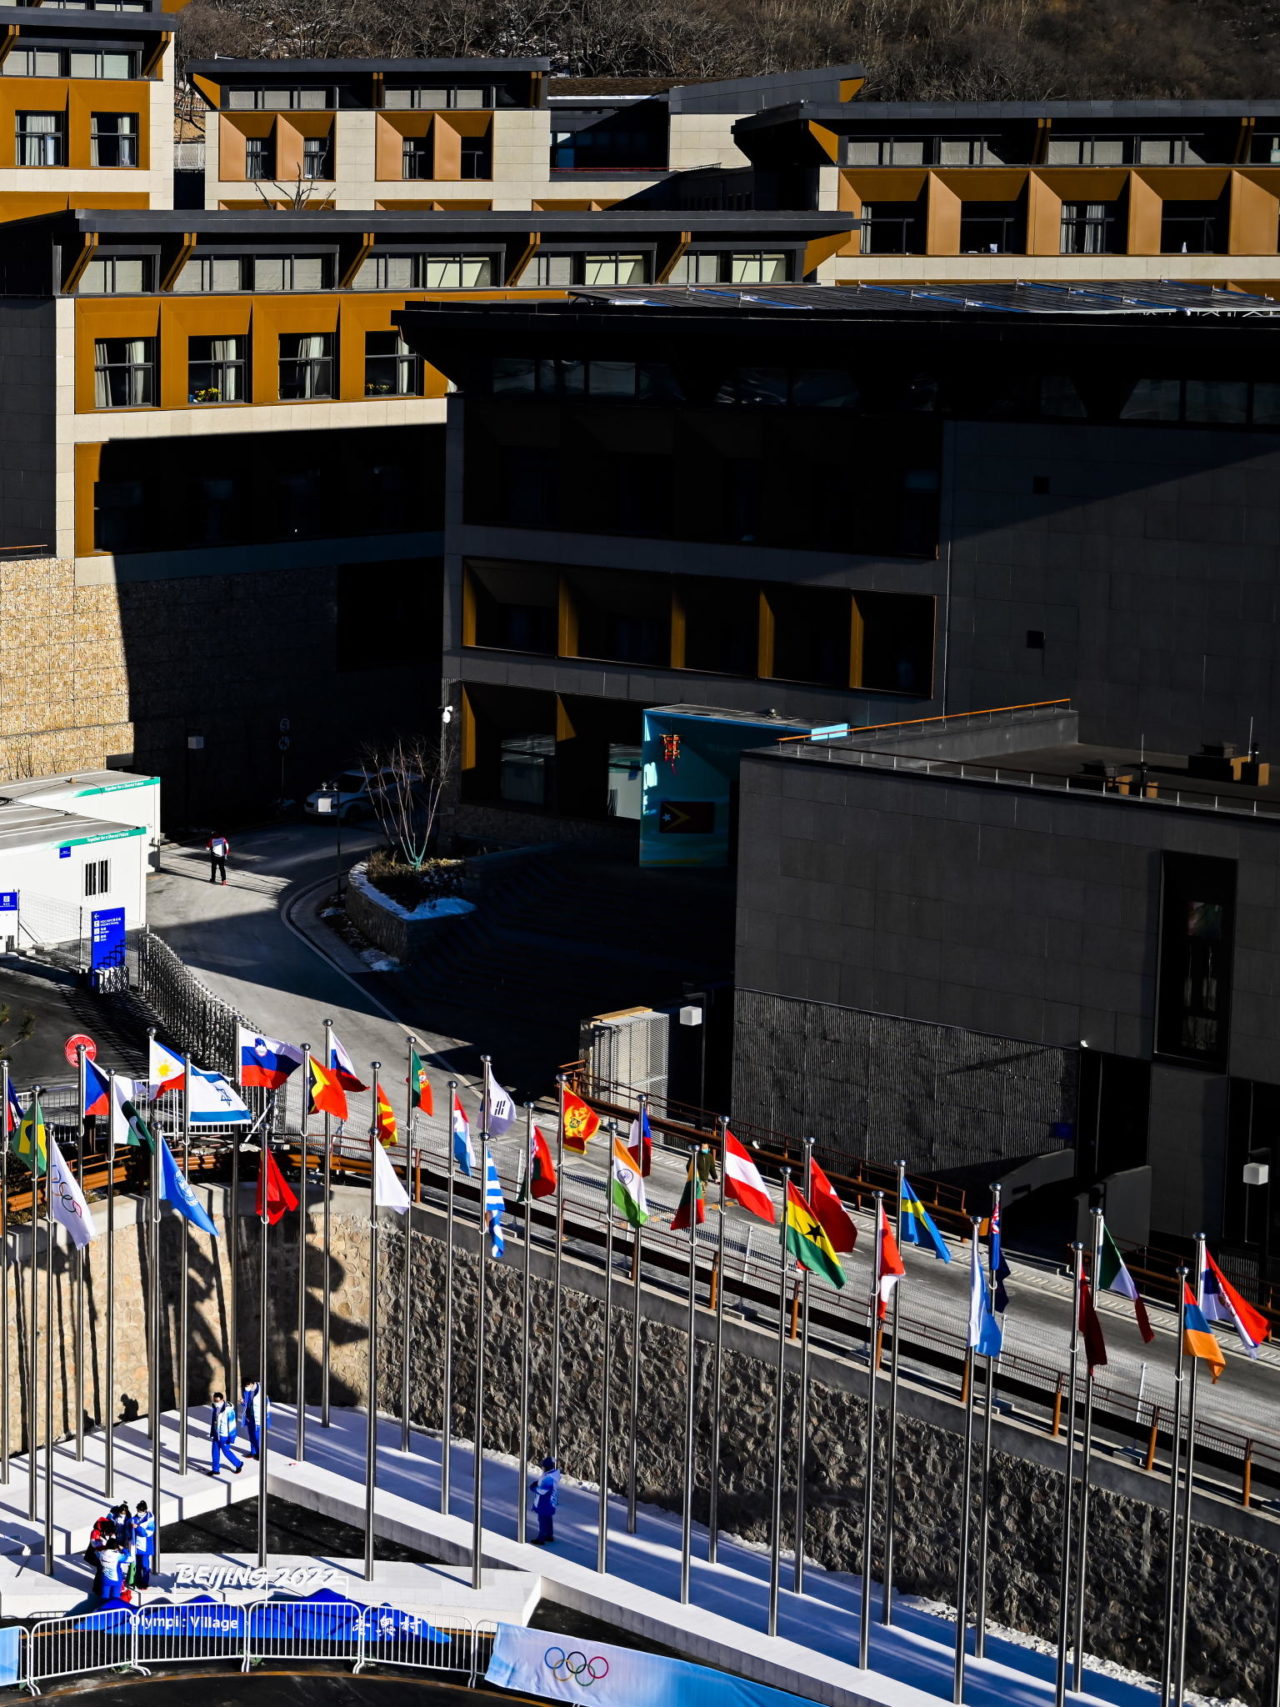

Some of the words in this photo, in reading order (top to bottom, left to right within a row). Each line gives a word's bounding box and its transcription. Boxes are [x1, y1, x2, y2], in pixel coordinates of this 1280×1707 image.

[174, 1562, 268, 1591] BEIJING
[271, 1565, 345, 1588] 2022
[190, 1615, 239, 1632] Village
